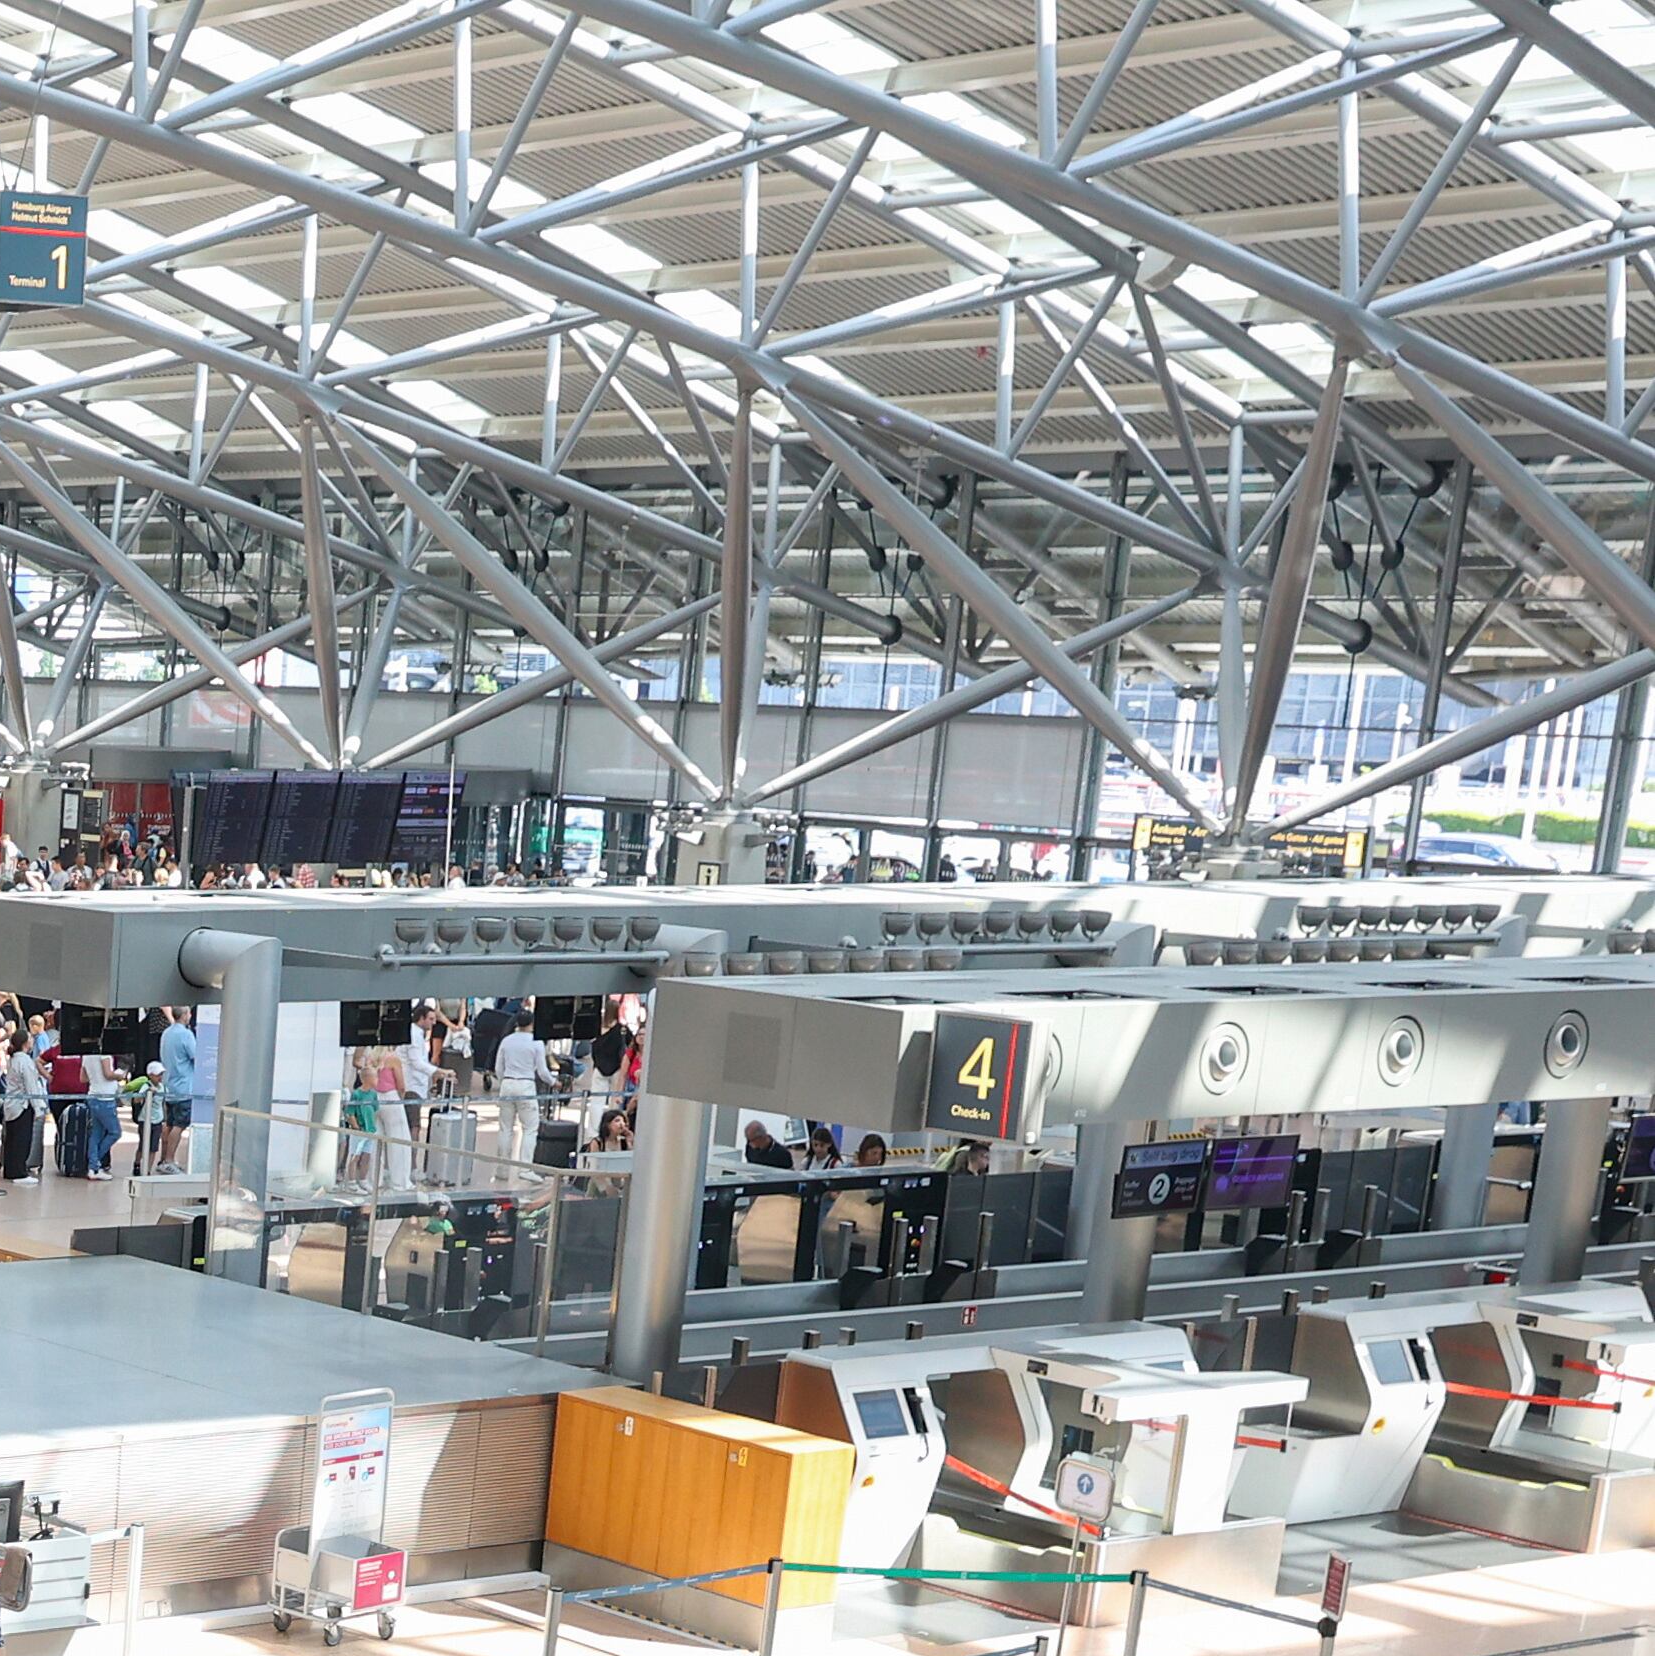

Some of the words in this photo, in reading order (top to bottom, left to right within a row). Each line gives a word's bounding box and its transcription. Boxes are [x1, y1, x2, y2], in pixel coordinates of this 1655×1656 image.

[12, 201, 45, 213] Hamburg
[46, 203, 72, 215] Airport
[12, 212, 38, 223] Helmut
[39, 214, 69, 225] Schmidt
[50, 244, 67, 290] 1
[9, 275, 46, 288] Terminal
[958, 1037, 996, 1100] 4
[951, 1104, 991, 1120] Check-in
[1153, 1178, 1165, 1199] 2
